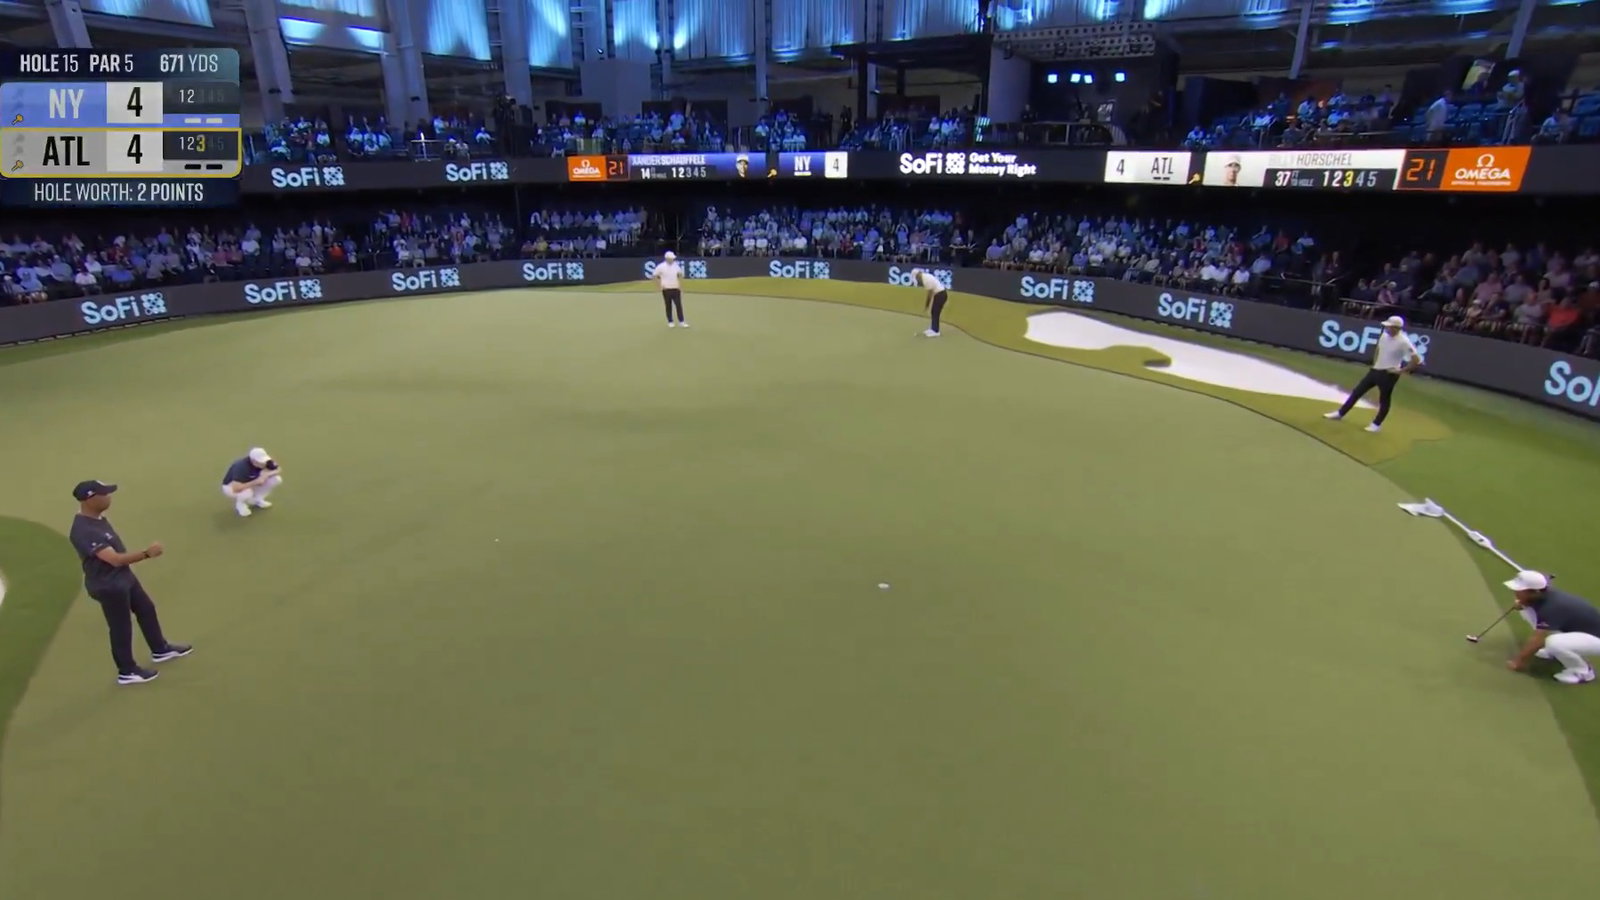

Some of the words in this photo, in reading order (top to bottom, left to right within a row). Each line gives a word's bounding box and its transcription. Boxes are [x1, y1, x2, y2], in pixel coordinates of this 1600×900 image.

[794, 156, 811, 171] NY
[832, 157, 840, 172] 4
[899, 152, 943, 174] SoFi
[969, 152, 990, 163] Get
[991, 152, 1017, 163] Your
[1116, 158, 1125, 176] 4
[1151, 156, 1174, 174] ATL
[1296, 153, 1352, 166] HORSCHEL
[445, 162, 487, 182] SoFi
[608, 160, 624, 175] 21
[640, 168, 651, 179] 14
[968, 163, 1006, 177] Money
[1006, 163, 1037, 177] Right
[1406, 158, 1436, 181] 21
[1454, 167, 1511, 180] OMEGA
[271, 167, 320, 188] SoFi
[1274, 170, 1291, 187] 37
[523, 262, 564, 281] SoFi
[644, 260, 685, 279] Si
[769, 260, 810, 279] SoFi
[392, 270, 437, 291] SoFi
[1020, 275, 1068, 300] SoFi
[244, 281, 296, 304] SoFi
[81, 296, 140, 325] SoFi
[1158, 292, 1206, 323] SoFi
[1319, 319, 1381, 354] SoF
